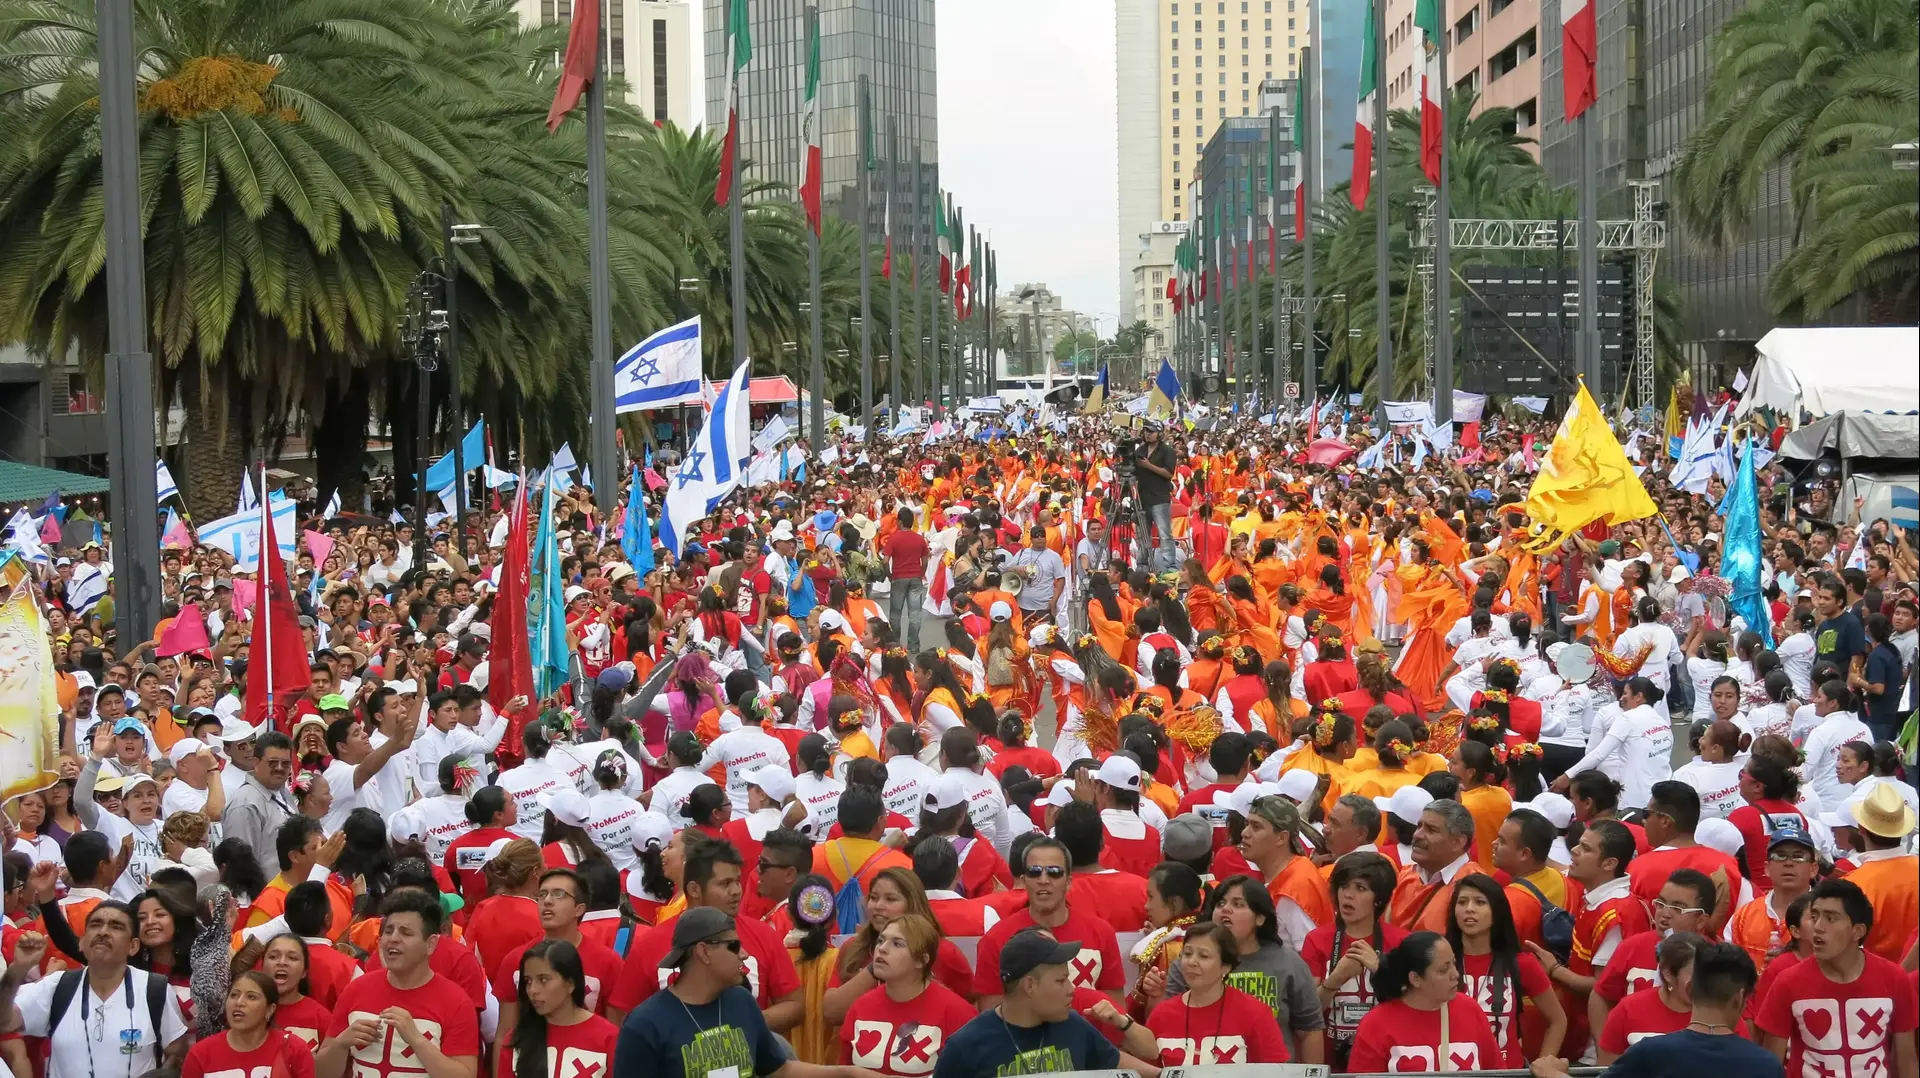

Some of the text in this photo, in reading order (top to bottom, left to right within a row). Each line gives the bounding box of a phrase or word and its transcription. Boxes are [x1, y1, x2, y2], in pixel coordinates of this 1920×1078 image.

[808, 790, 840, 804] Marcho
[890, 793, 918, 809] Por un
[972, 788, 993, 801] archo
[523, 801, 539, 811] Por
[968, 804, 990, 817] or un
[1718, 800, 1735, 811] Por
[587, 809, 636, 832] #YoMarcho
[601, 825, 631, 841] Por un
[603, 836, 633, 853] vivamie
